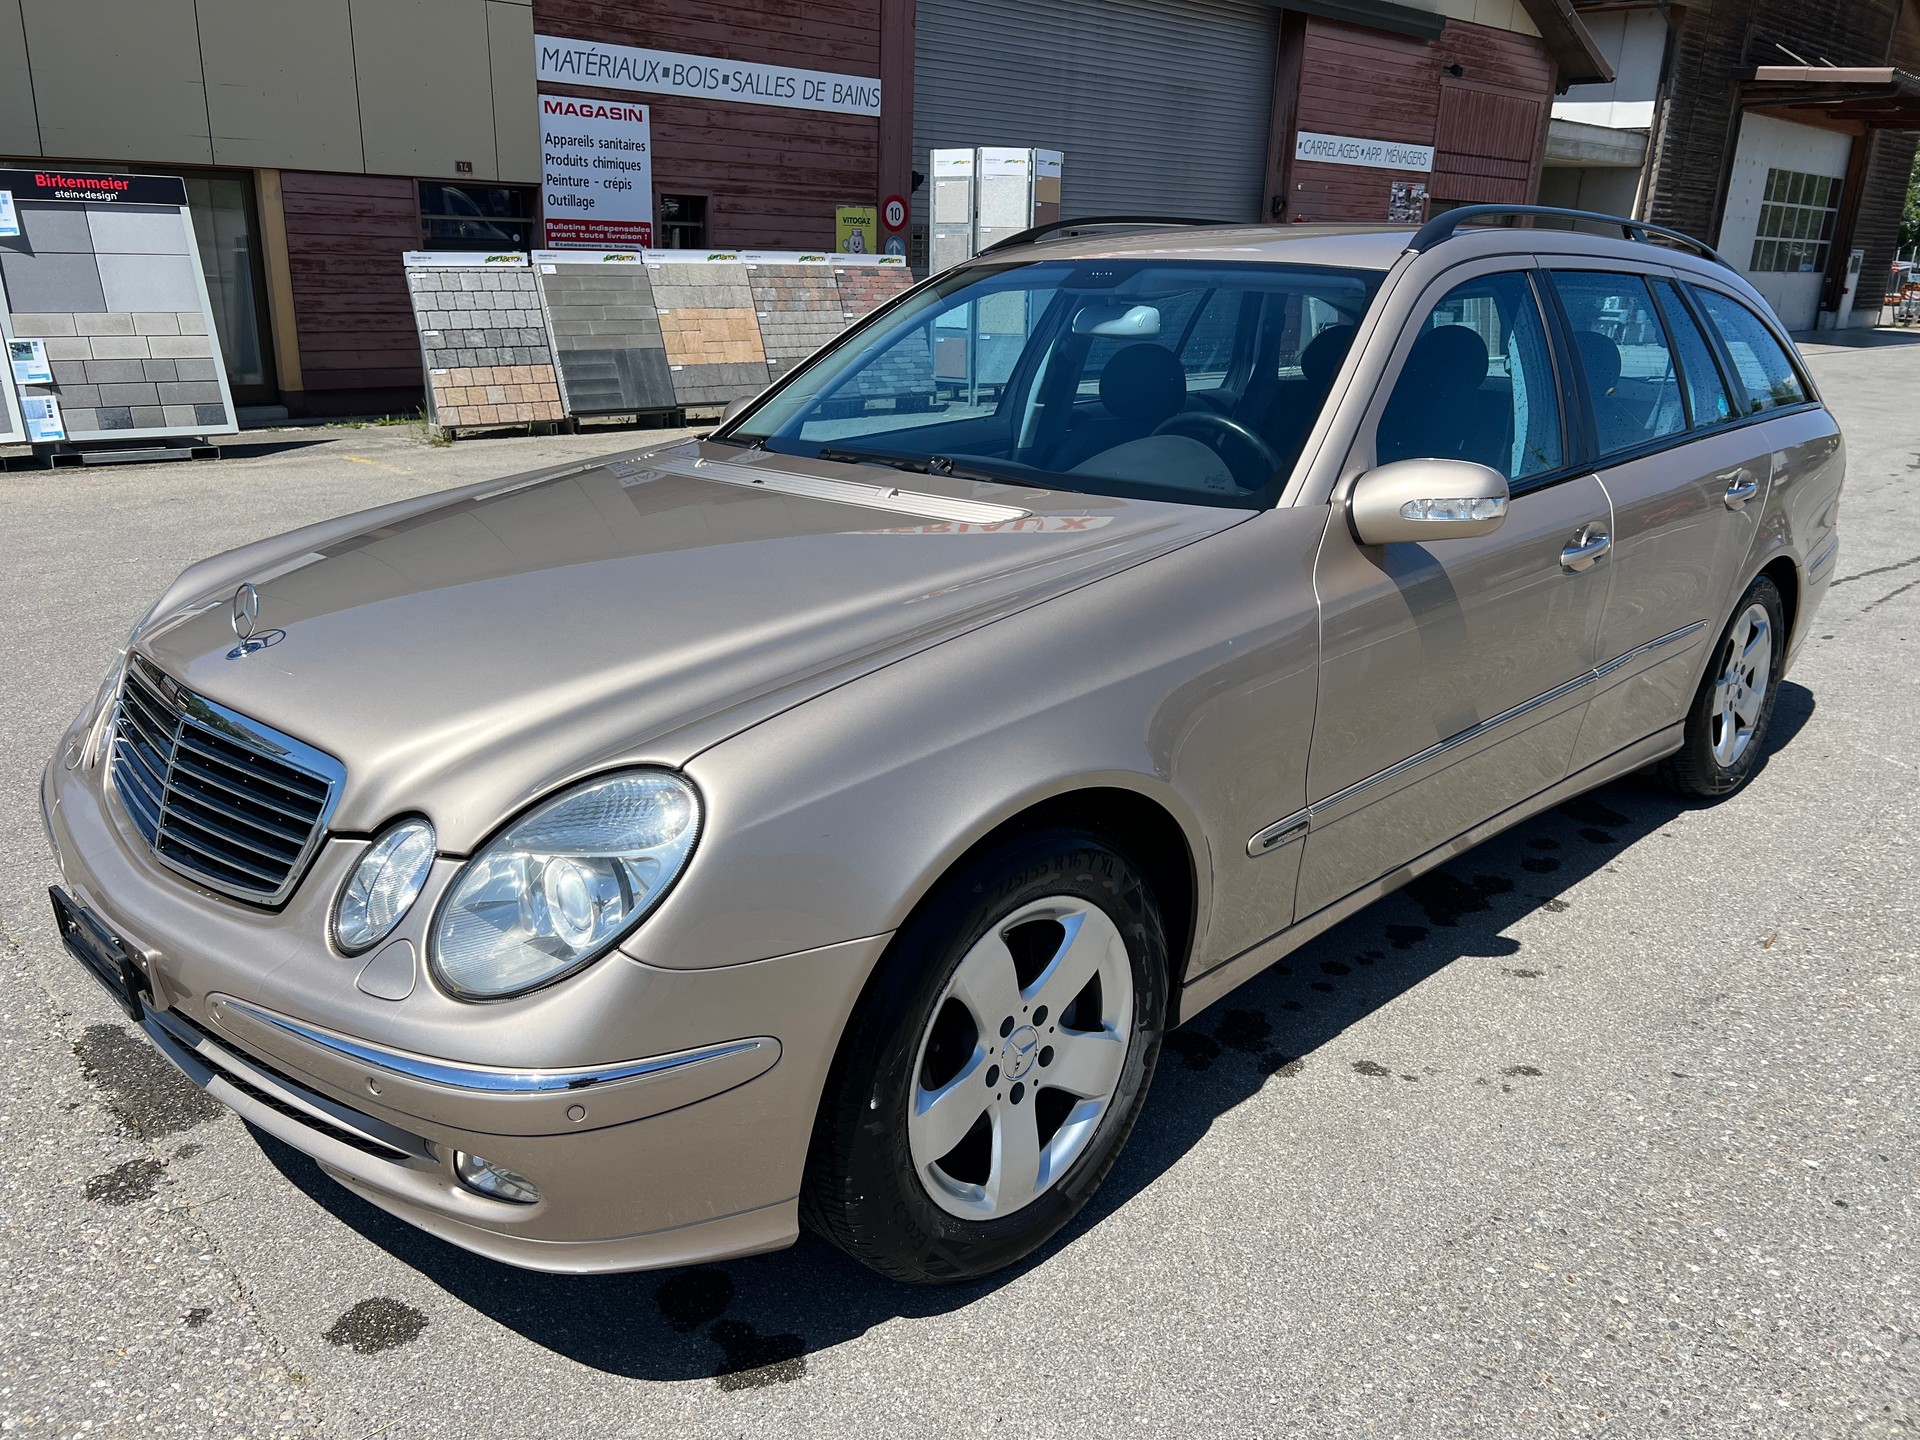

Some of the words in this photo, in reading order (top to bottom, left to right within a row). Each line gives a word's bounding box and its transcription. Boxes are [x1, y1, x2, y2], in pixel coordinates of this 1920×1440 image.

[541, 47, 660, 84] MATÉRIAUX
[672, 63, 720, 90] BOIS
[730, 71, 796, 98] SALLES
[802, 79, 826, 102] DE
[832, 83, 880, 108] BAINS
[544, 100, 643, 122] MAGASIN
[545, 132, 594, 149] Appareils
[598, 137, 646, 152] sanitaires
[1303, 139, 1360, 160] CARRELAGES
[1364, 146, 1382, 162] APP.
[1384, 145, 1428, 166] MÉNAGERS
[460, 163, 469, 171] 14
[545, 153, 588, 168] Produits
[592, 156, 641, 173] chimiques
[35, 174, 129, 190] Birkenmeier
[546, 173, 590, 188] Peinture
[603, 177, 632, 192] crépis
[547, 194, 595, 210] Outillage
[842, 216, 871, 225] VITOGAZ
[889, 207, 901, 221] 10
[546, 222, 586, 231] Bulletins
[589, 224, 651, 233] indispensables
[580, 231, 604, 239] toute
[607, 232, 642, 240] livraison
